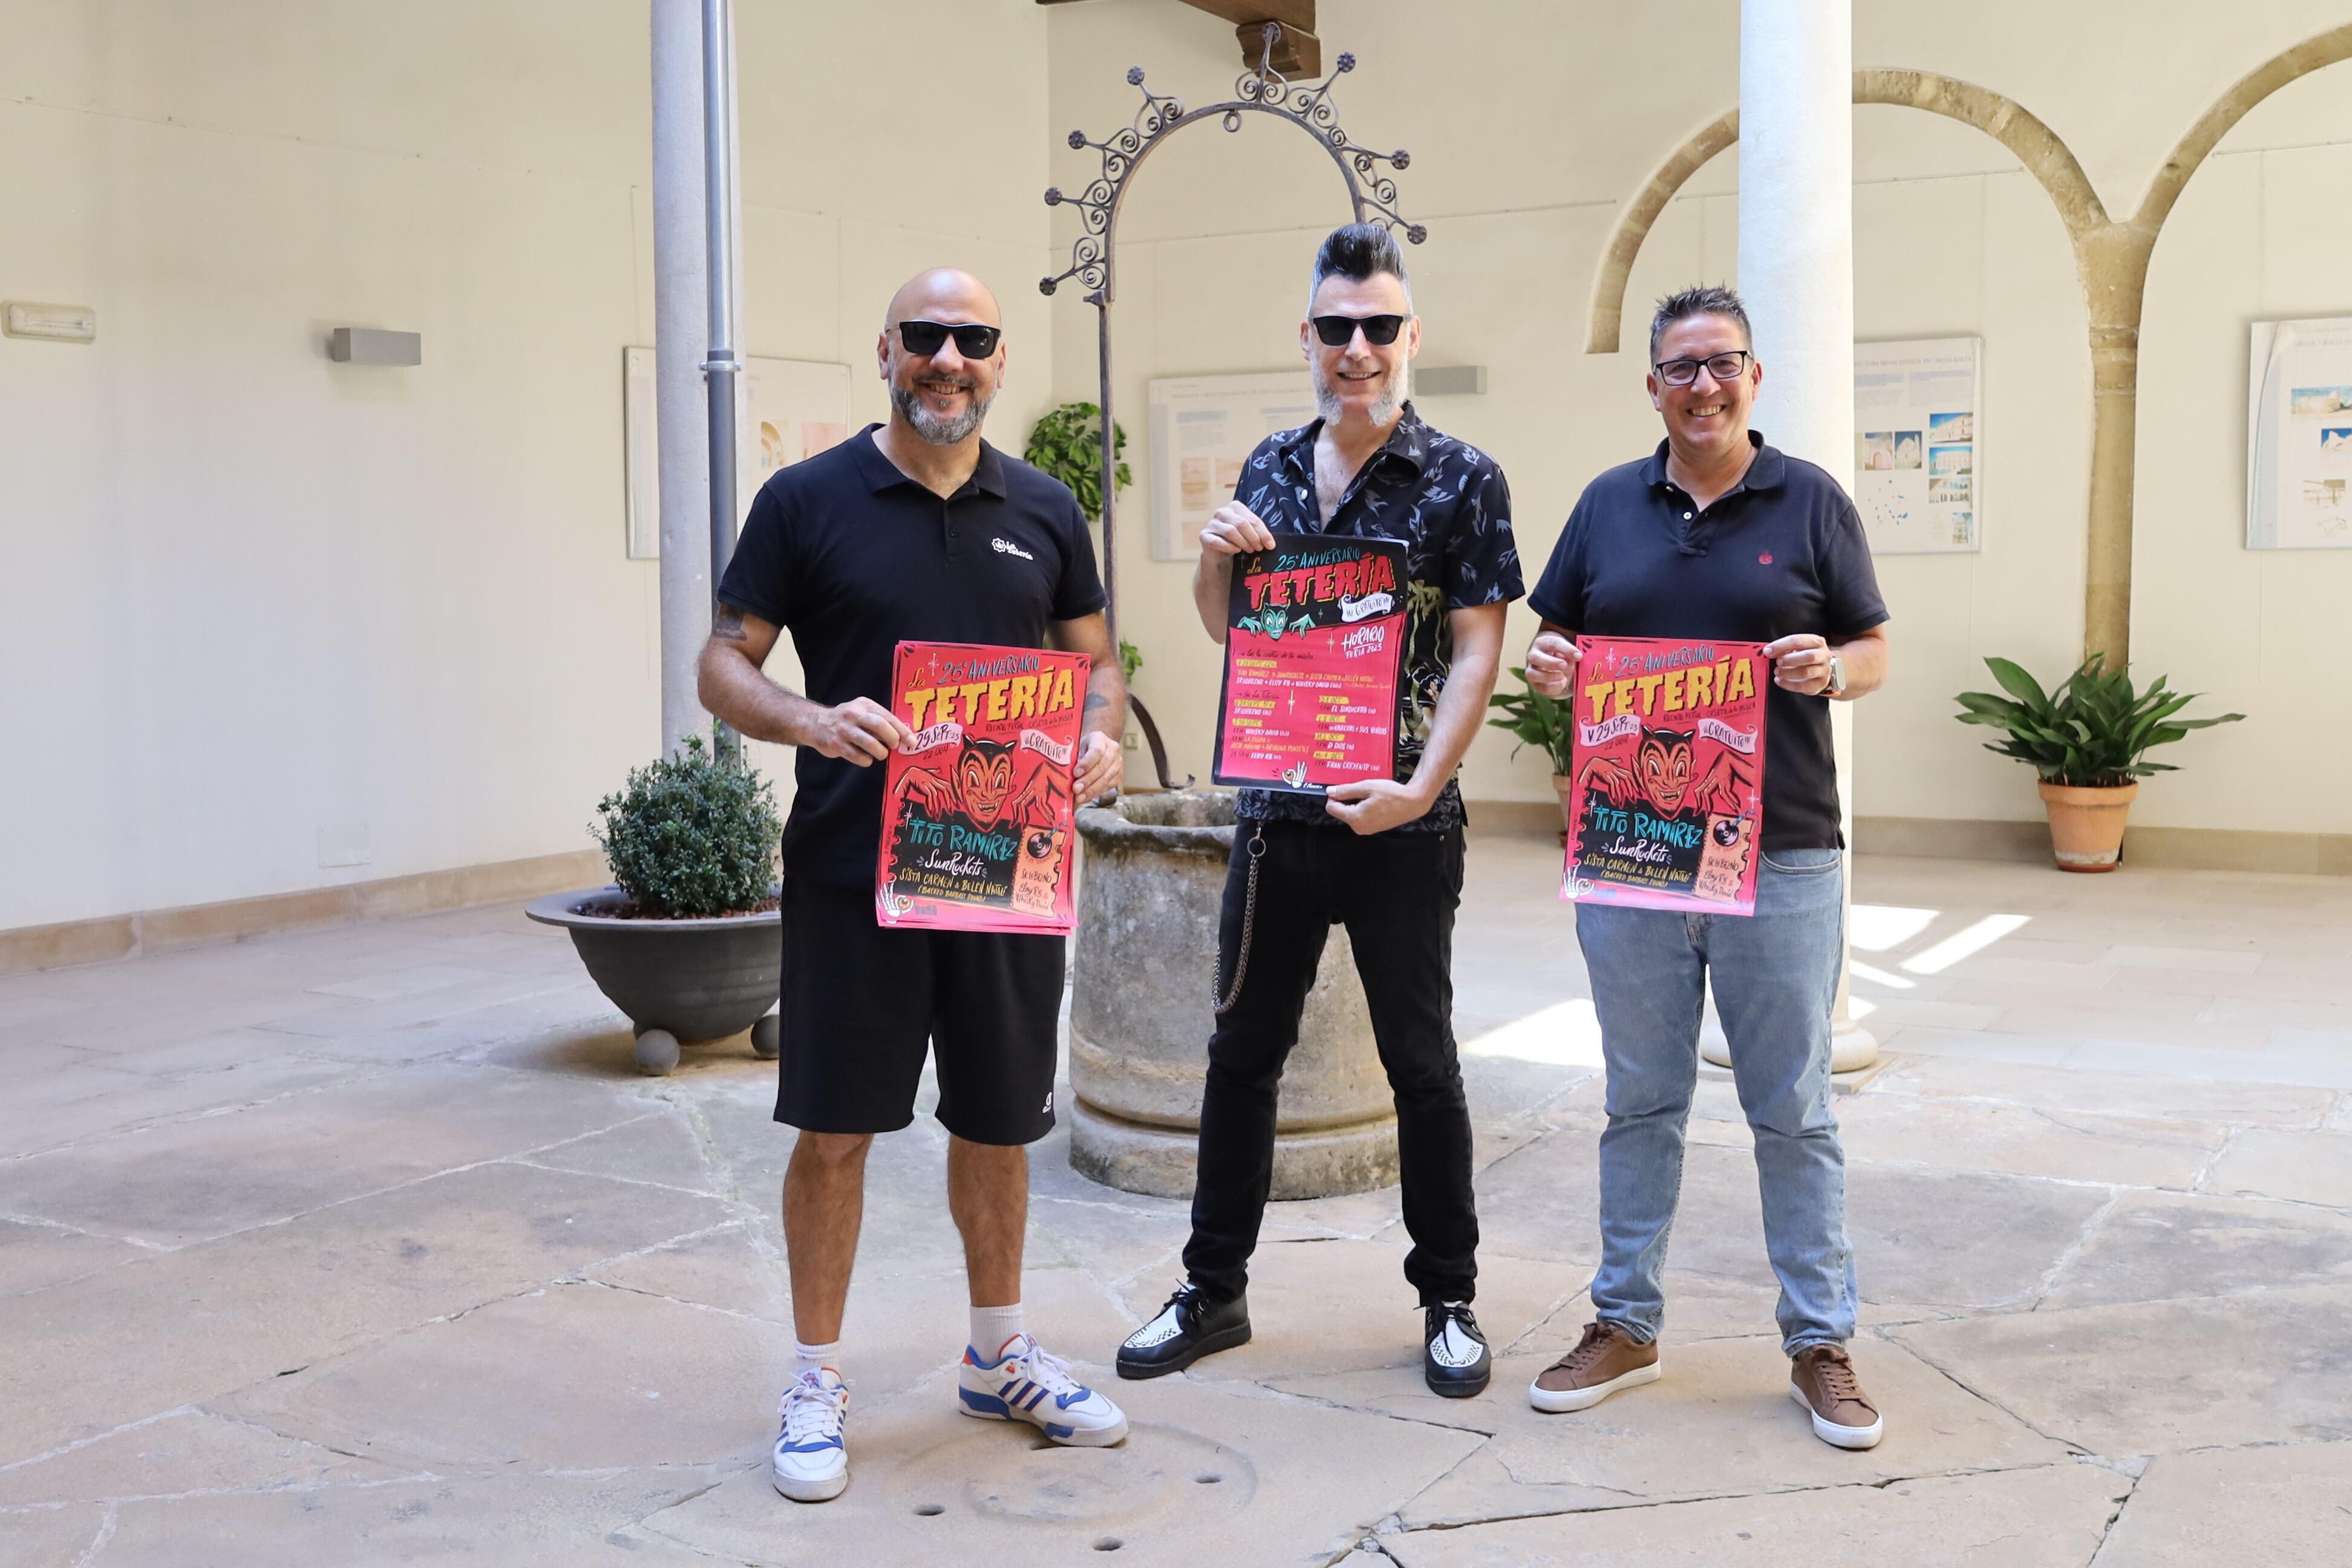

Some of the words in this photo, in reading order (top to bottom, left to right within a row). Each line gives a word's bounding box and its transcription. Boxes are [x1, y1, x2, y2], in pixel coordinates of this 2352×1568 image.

[1247, 557, 1263, 574] La
[1299, 546, 1361, 569] ANIVERSARIO
[1244, 551, 1397, 612] TETERÍA
[1341, 626, 1385, 652] HORARIO
[968, 653, 1040, 681] ANIVERSARIO
[1644, 644, 1714, 673] ANIVERSARIO
[907, 667, 926, 687] La
[1587, 662, 1603, 682] La
[904, 665, 1074, 731] TETERÍA
[1584, 655, 1755, 724] TETERÍA
[1342, 761, 1370, 771] CREYENTE
[909, 817, 946, 846] TITO
[950, 825, 1018, 861] RAMÍREZ
[1593, 805, 1628, 834] TITO
[1634, 812, 1705, 849] RAMÍREZ
[1607, 859, 1638, 875] CARMEN
[923, 873, 954, 889] CARMEN
